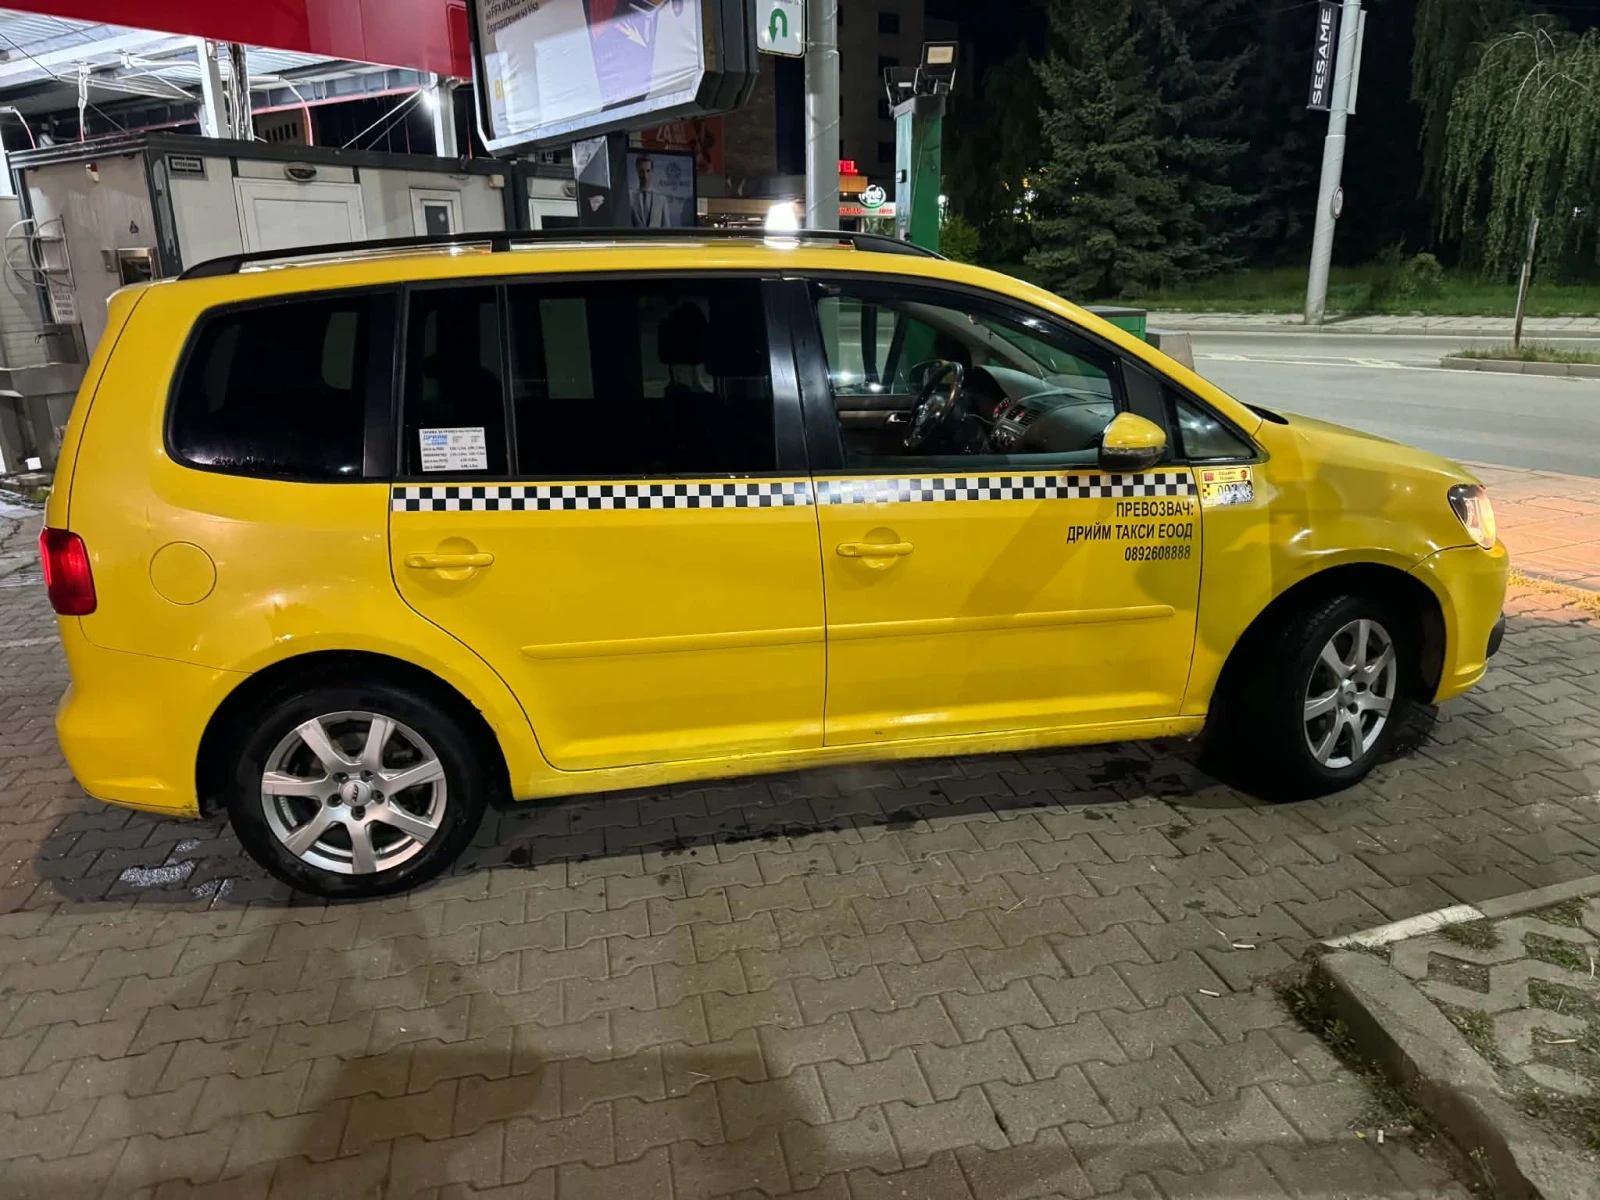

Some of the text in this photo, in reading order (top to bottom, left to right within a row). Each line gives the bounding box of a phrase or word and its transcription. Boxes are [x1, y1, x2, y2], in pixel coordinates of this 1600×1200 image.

[1312, 8, 1332, 105] SESAME
[1116, 501, 1194, 517] ПРЕВОЗВАЧ:
[1066, 522, 1193, 544] ДРИЙМ ТАКСИ ЕООД
[1124, 545, 1191, 561] 0892608888
